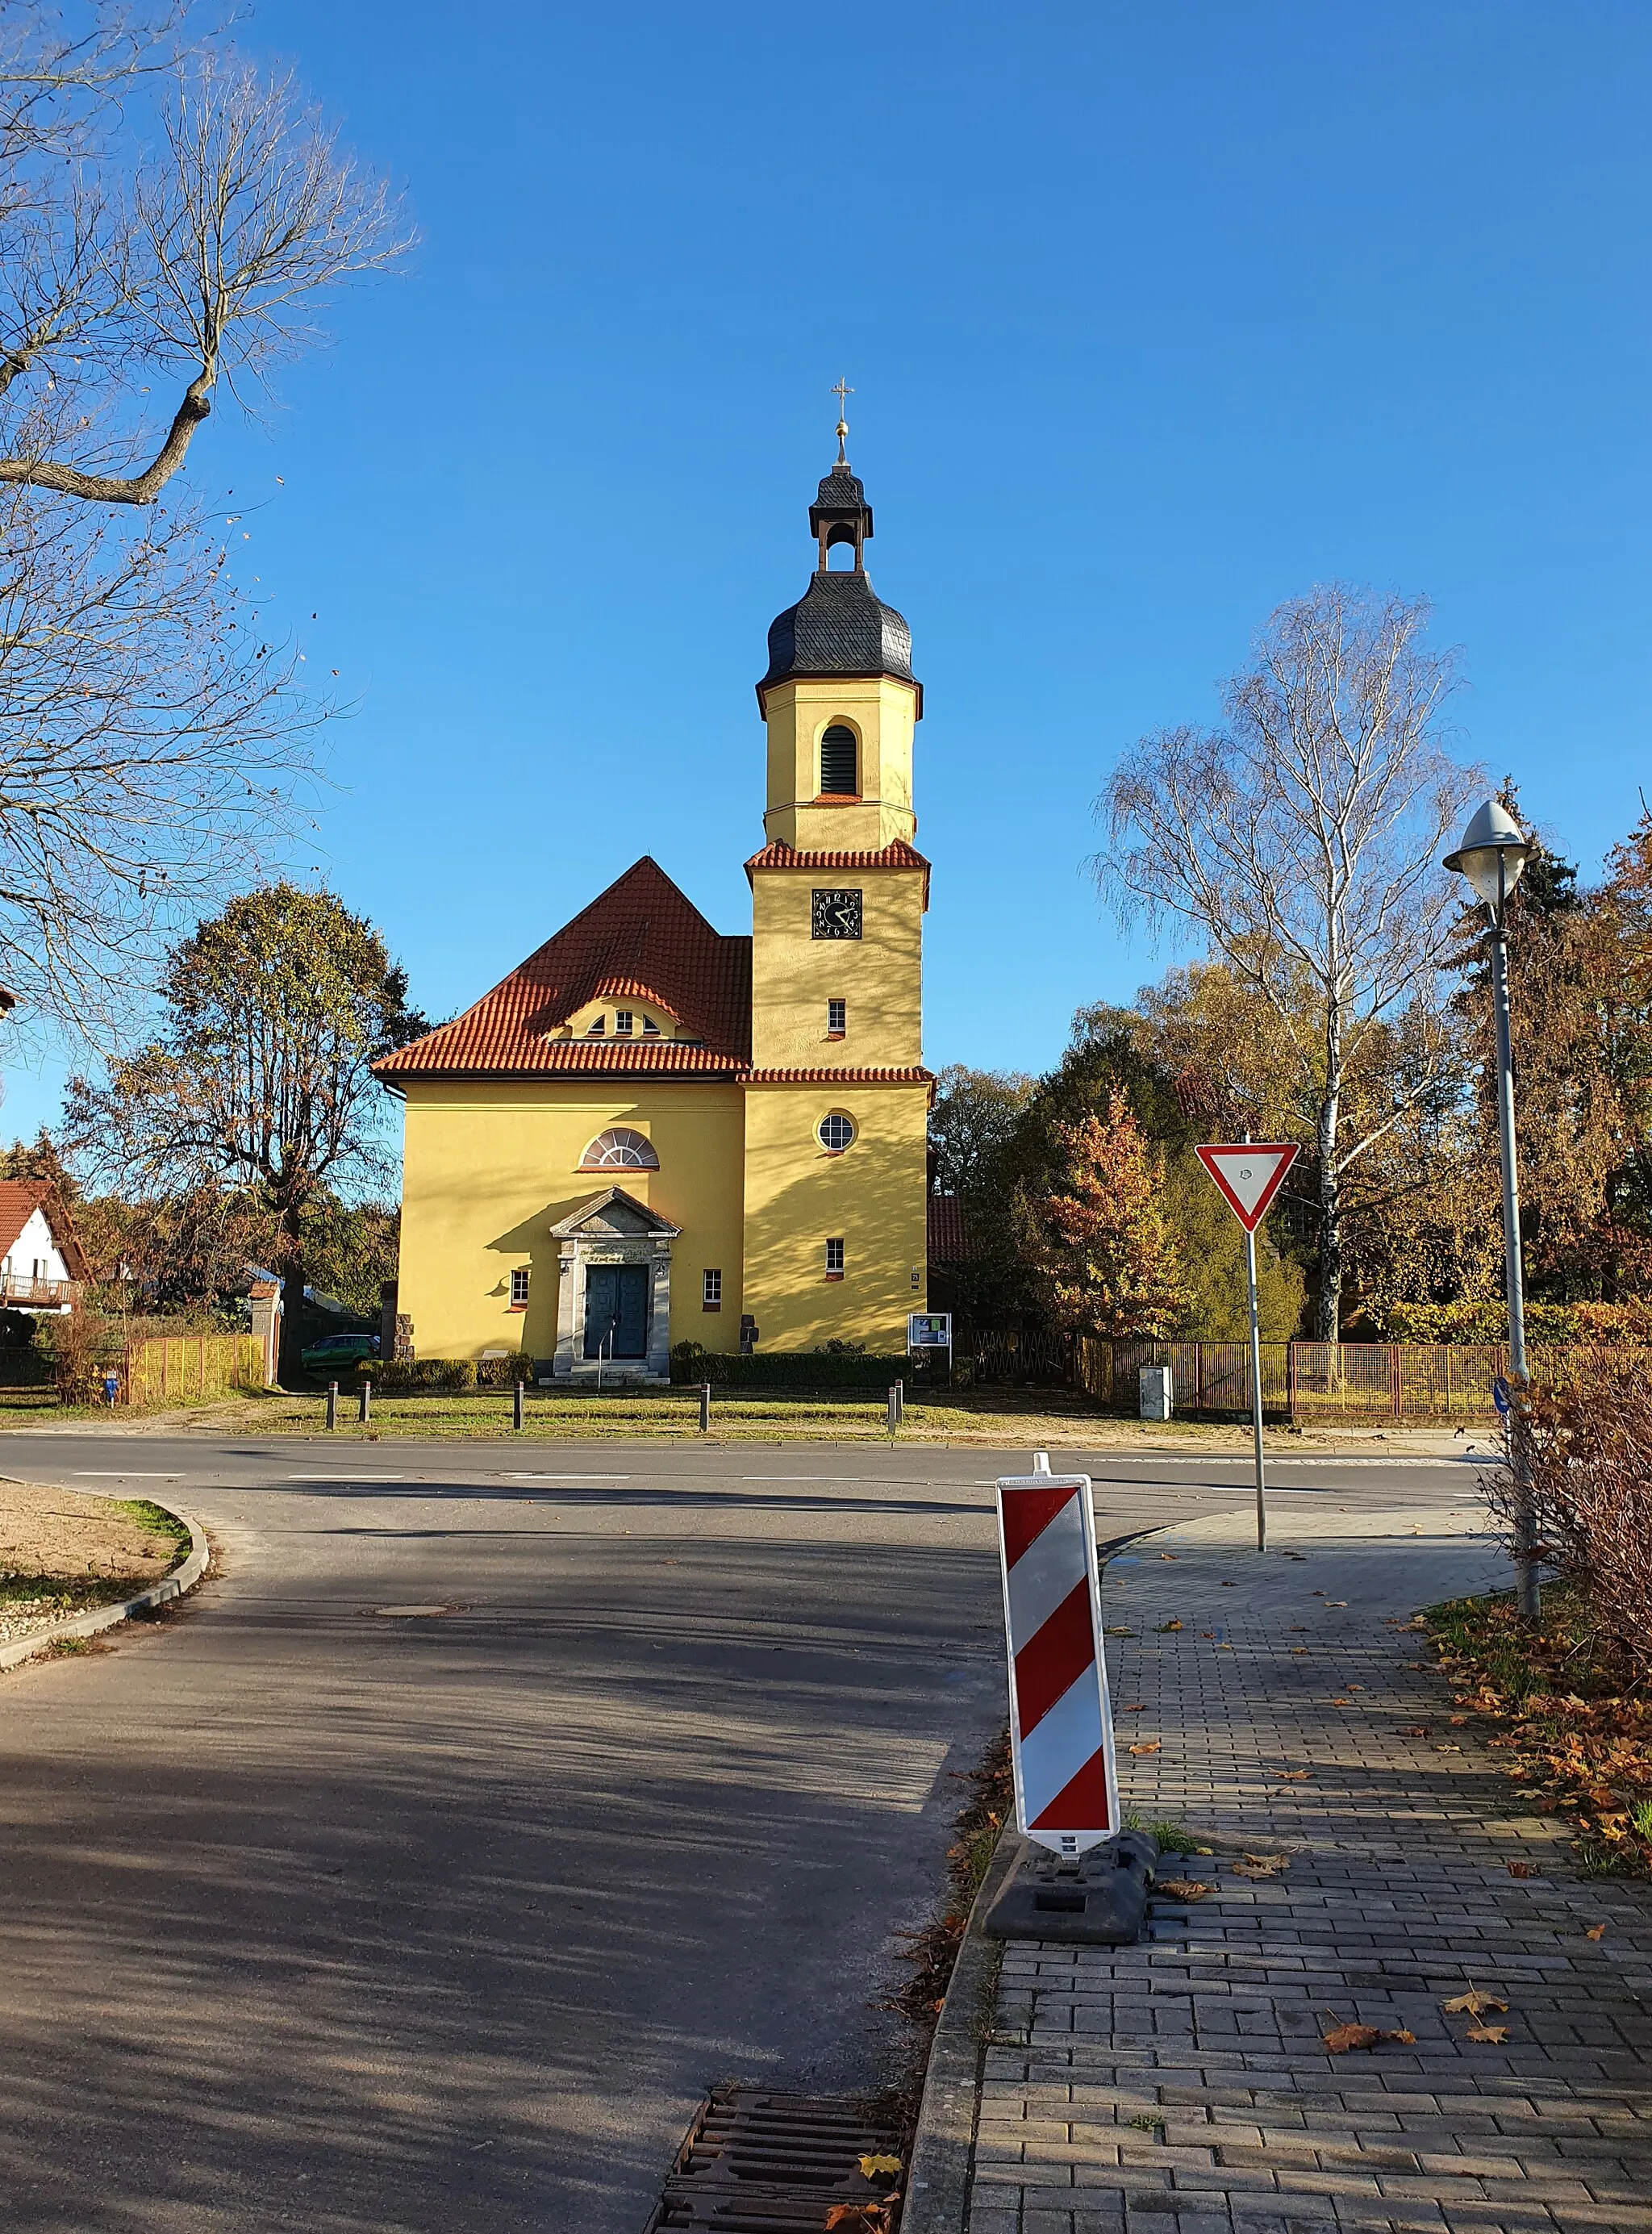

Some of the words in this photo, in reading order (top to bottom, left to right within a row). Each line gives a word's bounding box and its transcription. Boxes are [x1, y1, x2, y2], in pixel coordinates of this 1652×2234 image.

[834, 894, 840, 902] 12
[850, 902, 855, 910] 2
[816, 911, 822, 919] 9
[853, 911, 858, 919] 3
[827, 926, 831, 934] 7
